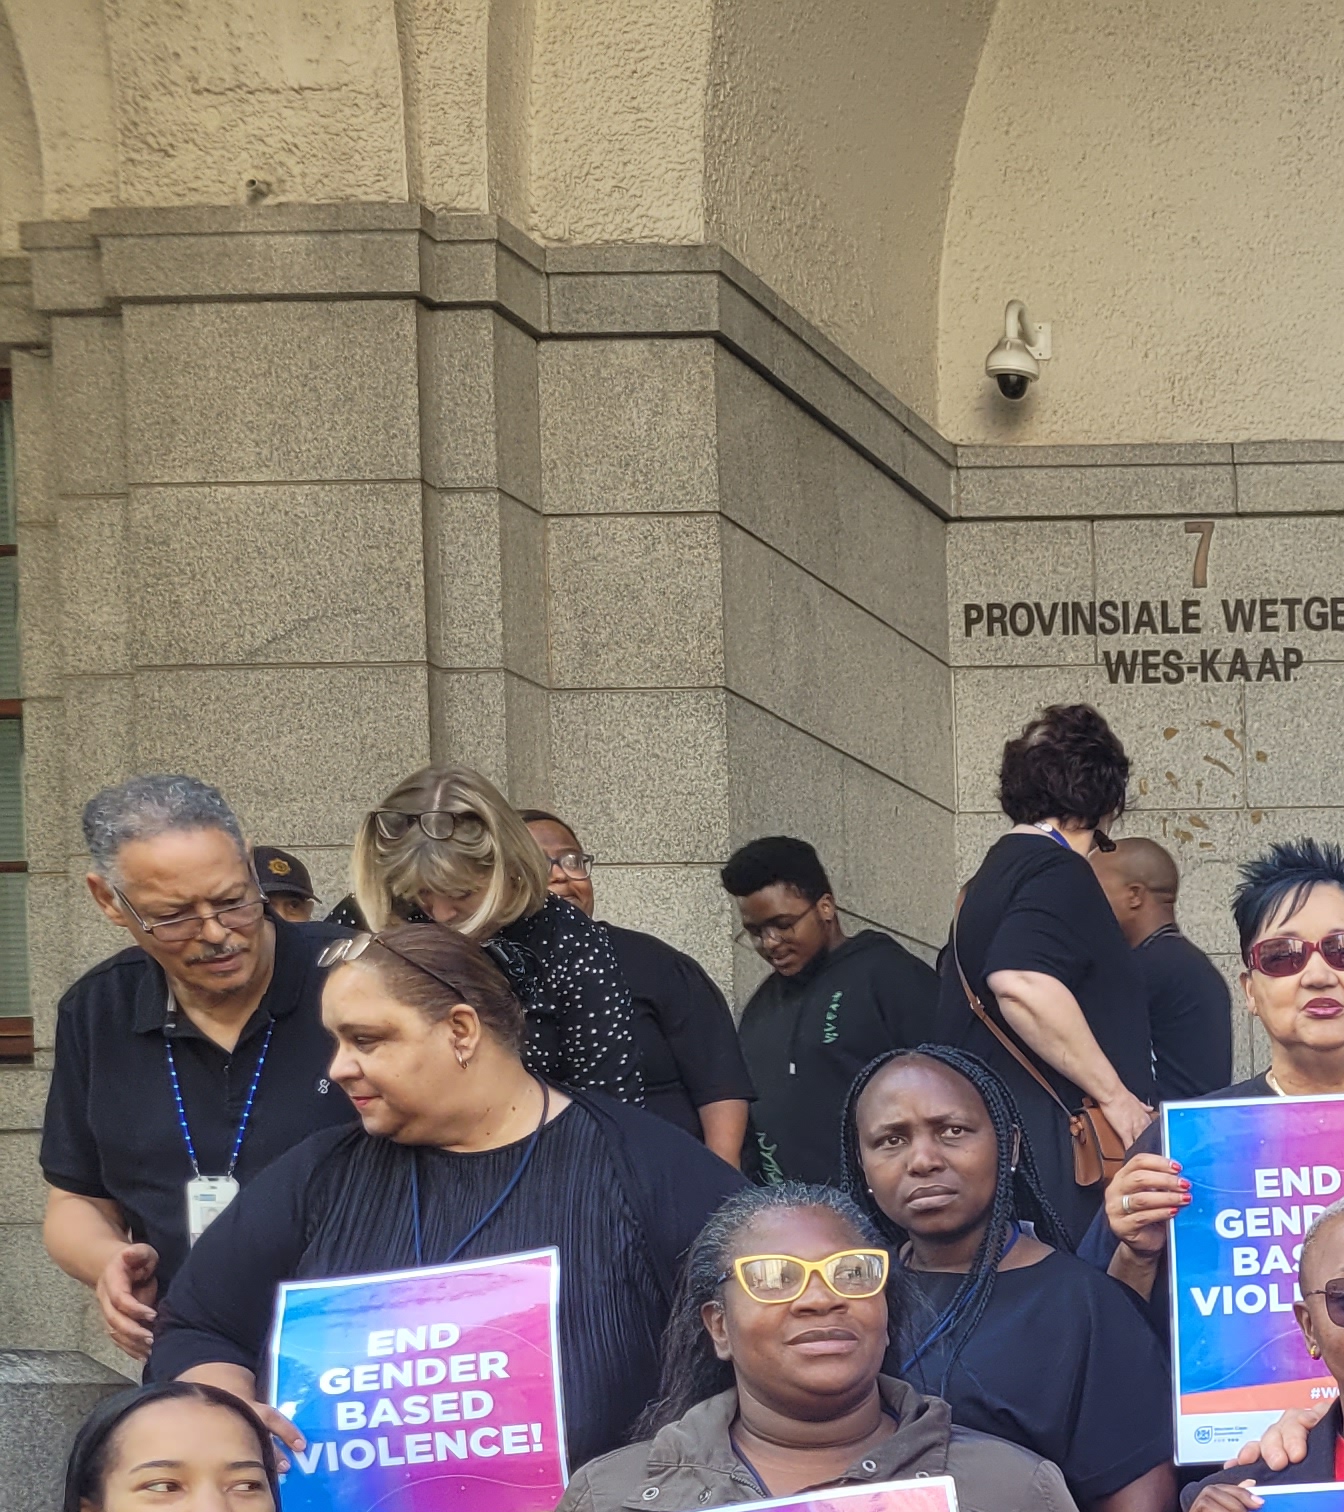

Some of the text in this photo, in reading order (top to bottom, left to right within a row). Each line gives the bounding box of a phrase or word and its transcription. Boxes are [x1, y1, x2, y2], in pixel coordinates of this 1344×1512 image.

[1184, 521, 1215, 589] 7
[964, 599, 1200, 638] PROVINSIALE
[1103, 647, 1304, 685] WES-KAAP
[1255, 1165, 1342, 1199] END
[366, 1322, 461, 1358] END
[319, 1350, 510, 1396] GENDER
[336, 1390, 495, 1432] BASED
[292, 1423, 544, 1476] VIOLENCE!
